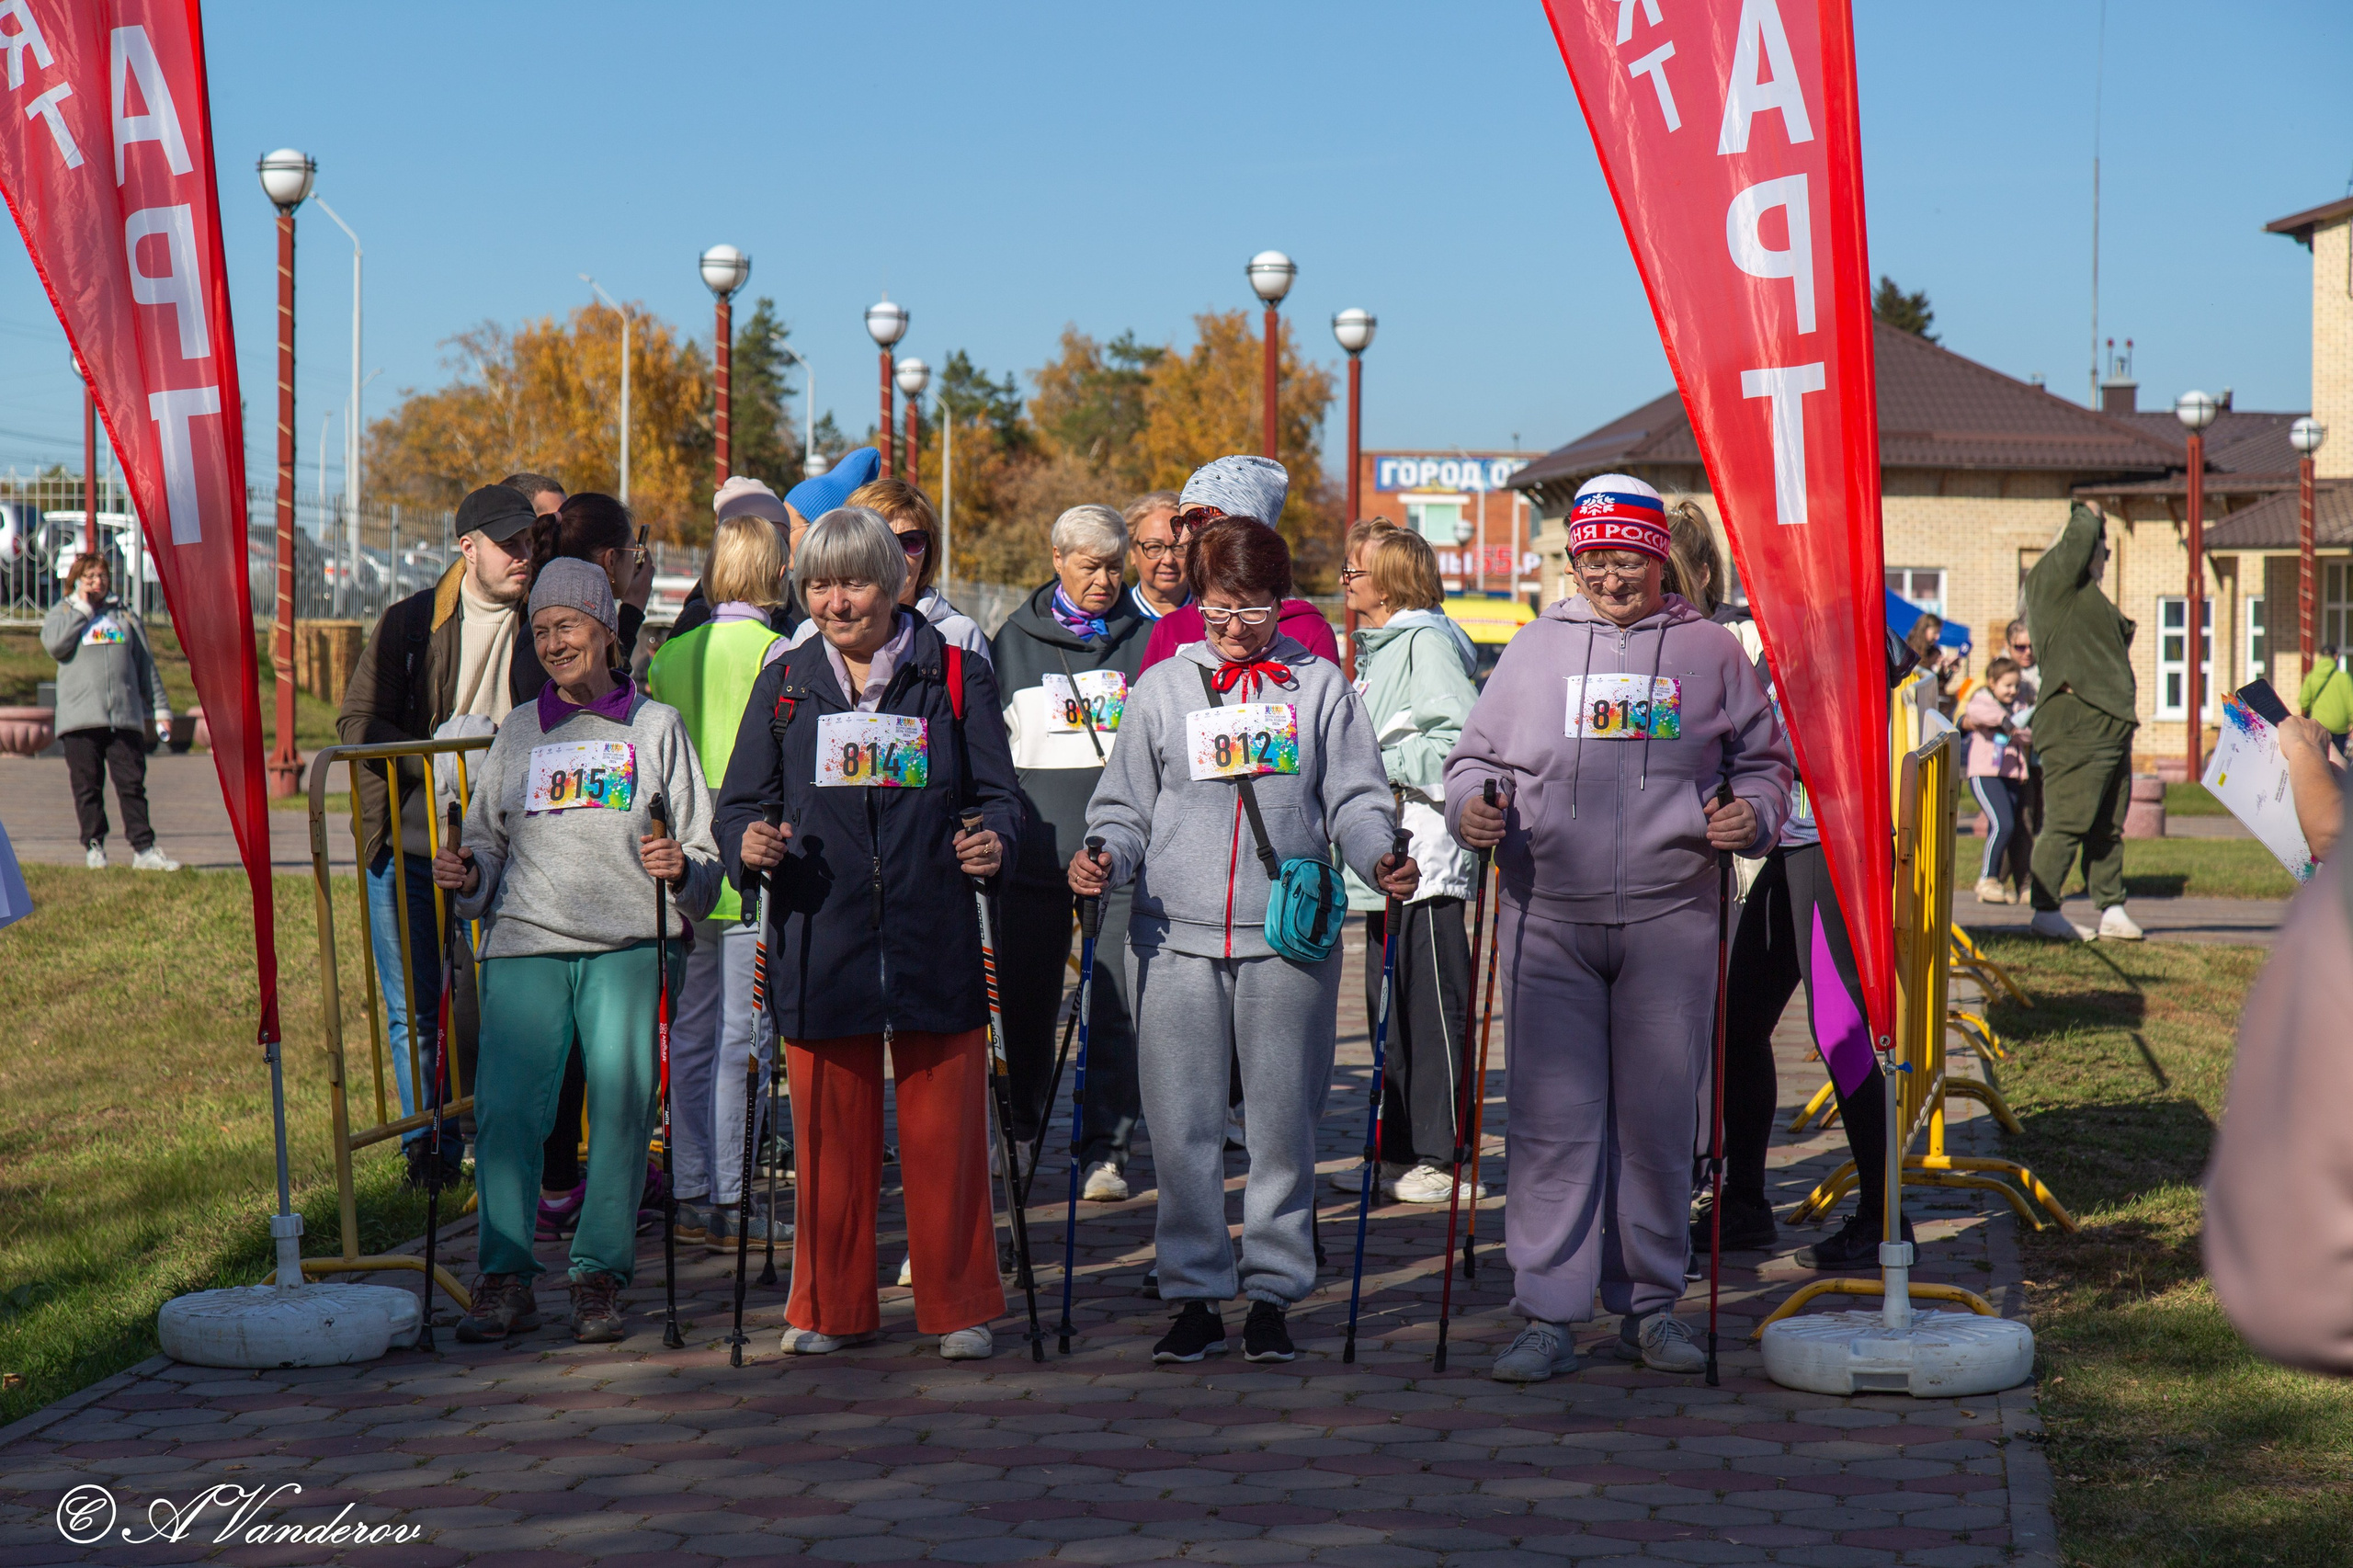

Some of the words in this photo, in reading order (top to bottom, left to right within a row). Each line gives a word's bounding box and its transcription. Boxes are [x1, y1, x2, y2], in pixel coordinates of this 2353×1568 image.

[1381, 460, 1483, 490] ГОРОД
[1593, 699, 1652, 730] 813
[843, 743, 901, 777] 814
[1214, 732, 1273, 767] 812
[550, 768, 606, 801] 815
